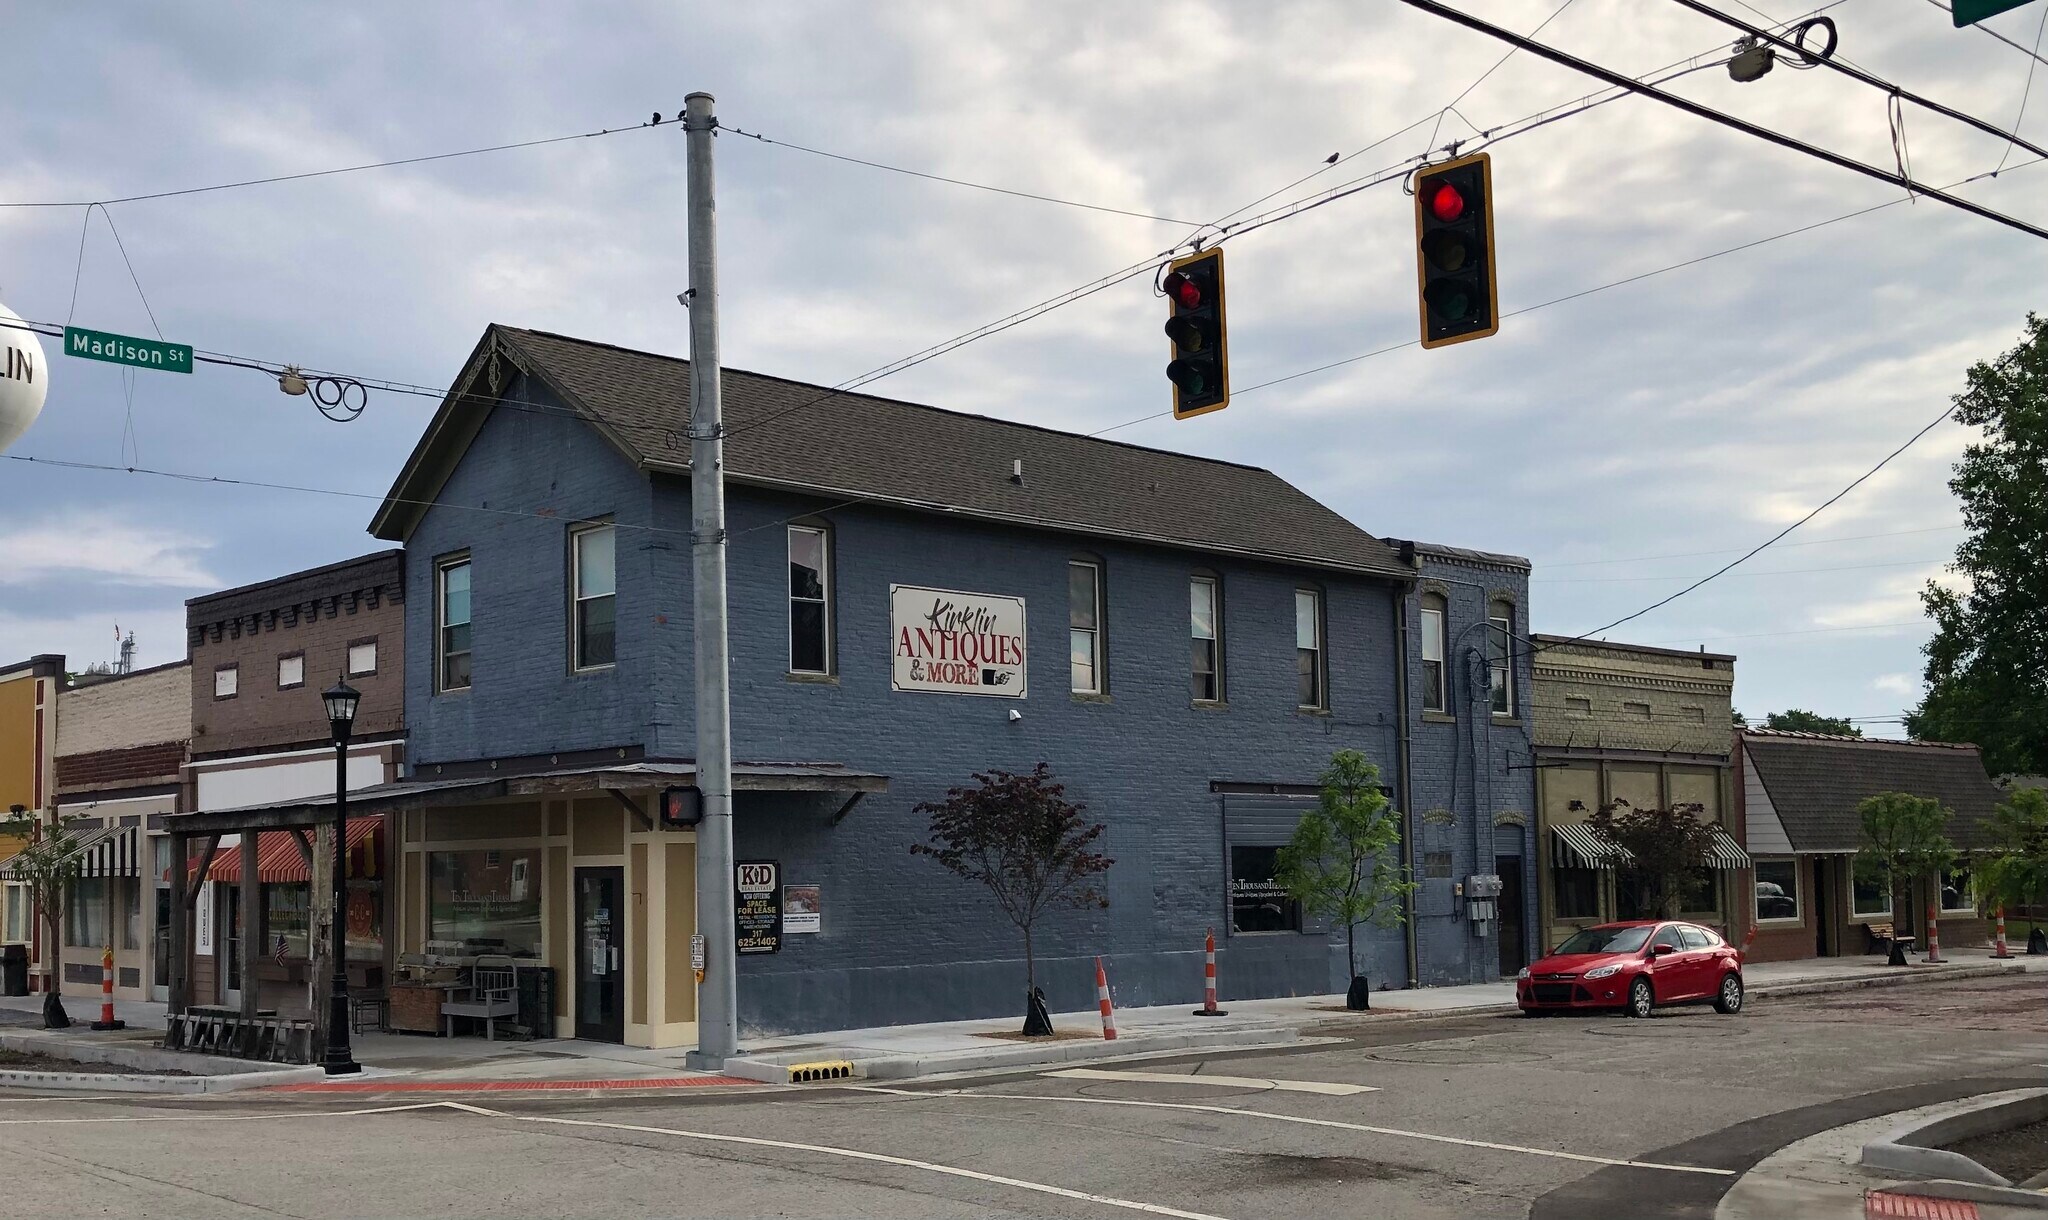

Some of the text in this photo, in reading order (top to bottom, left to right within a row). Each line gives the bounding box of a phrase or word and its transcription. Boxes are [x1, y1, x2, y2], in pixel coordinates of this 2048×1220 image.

[73, 333, 184, 364] Madison St
[0, 346, 33, 384] IN
[924, 598, 997, 640] Kirklin
[896, 625, 1022, 667] ANTIQUES
[909, 659, 980, 686] & MORE
[746, 900, 767, 908] SPACE
[753, 906, 776, 914] LEASE
[737, 937, 777, 947] 625-1402
[752, 930, 763, 938] 317
